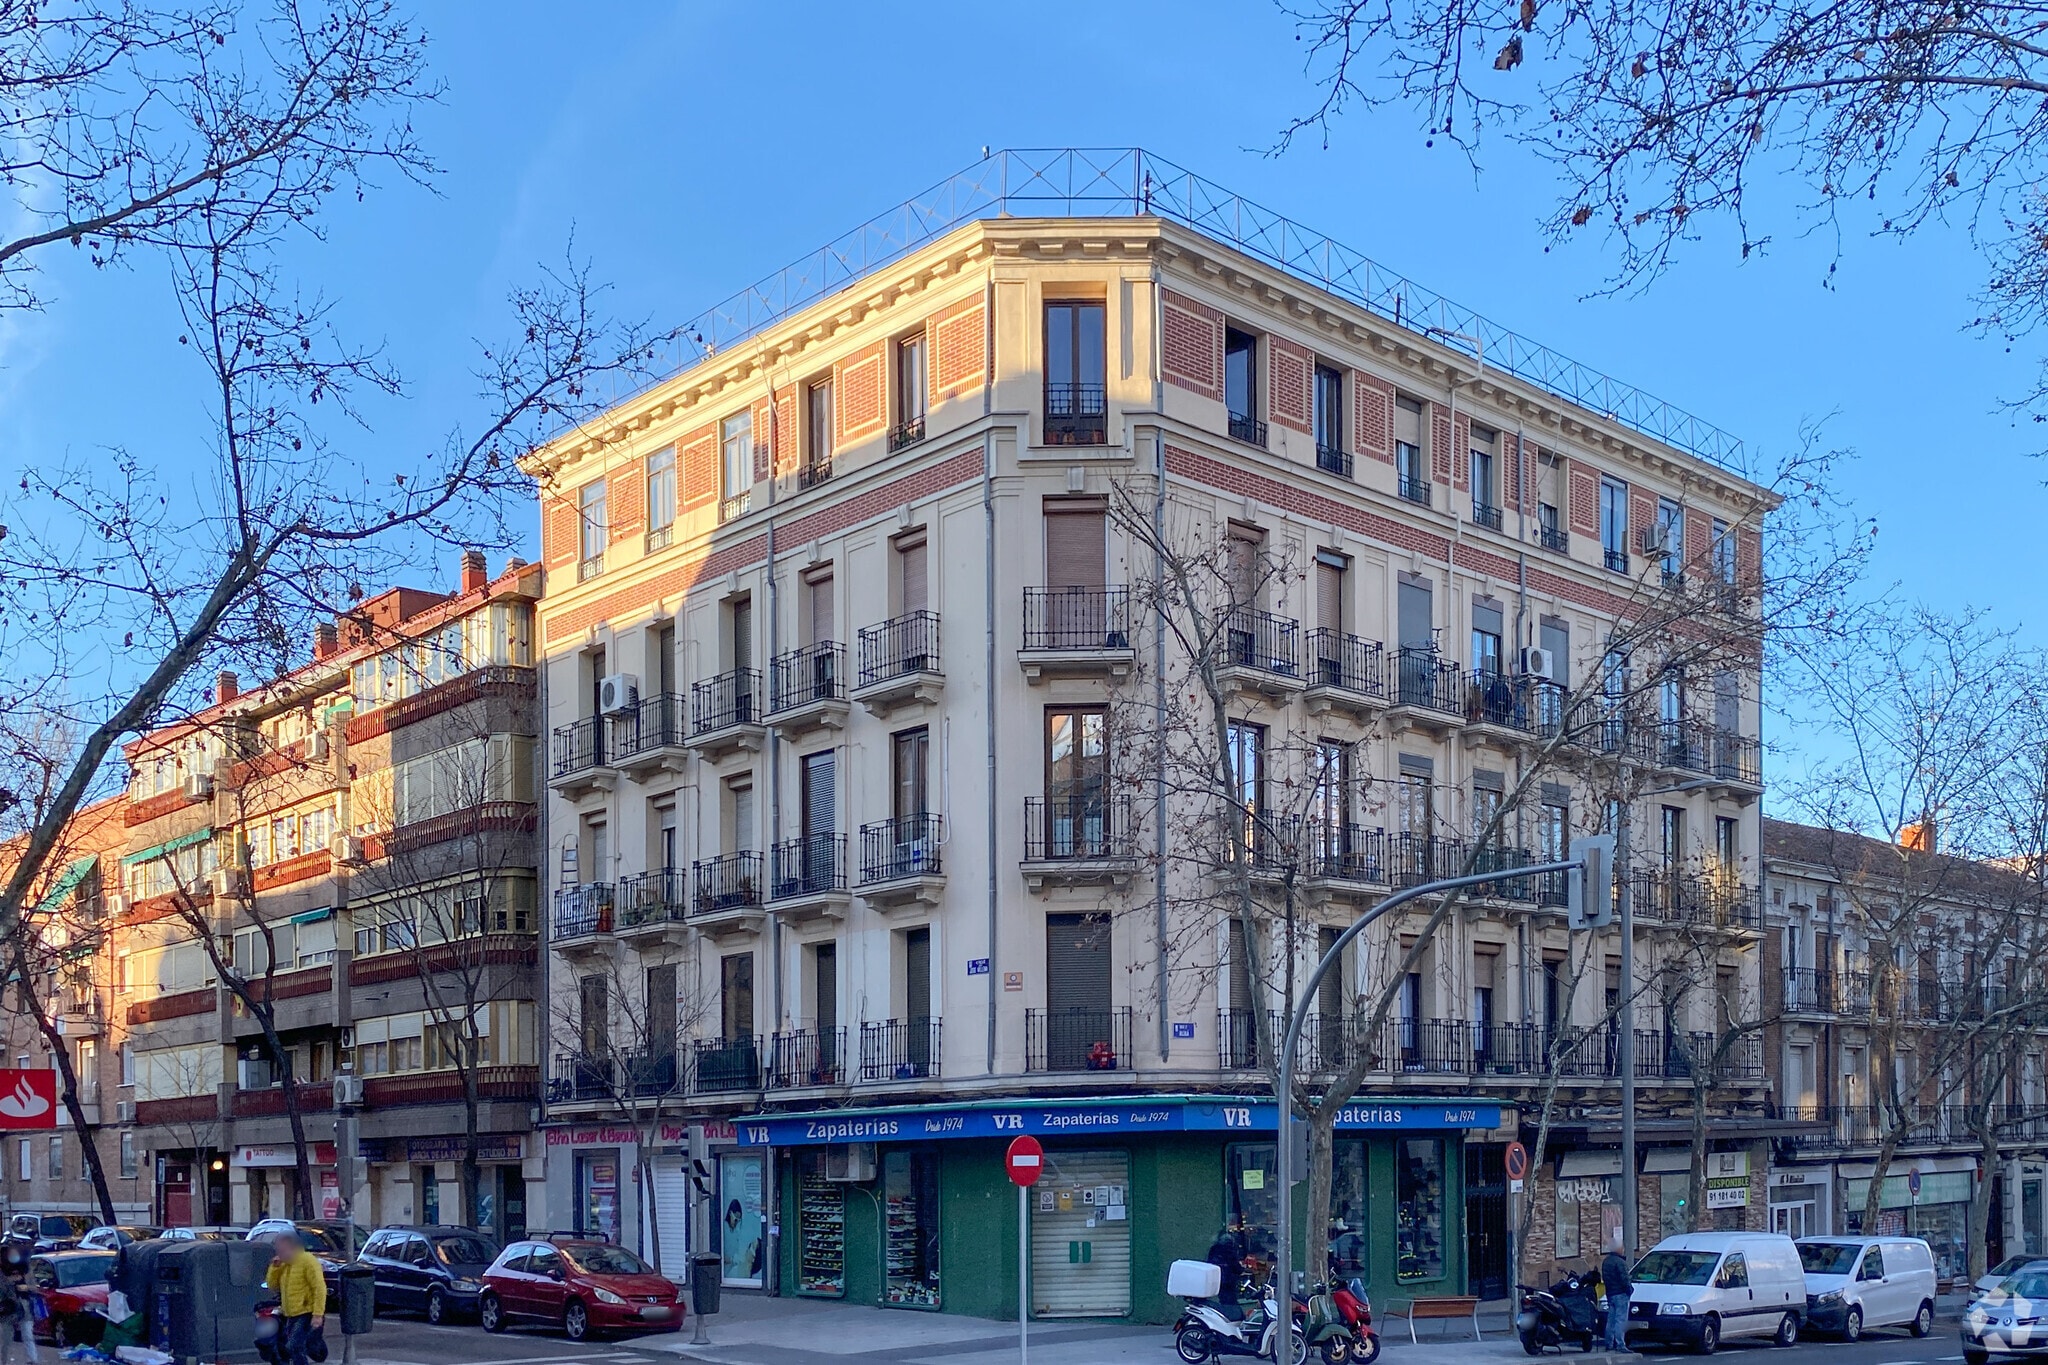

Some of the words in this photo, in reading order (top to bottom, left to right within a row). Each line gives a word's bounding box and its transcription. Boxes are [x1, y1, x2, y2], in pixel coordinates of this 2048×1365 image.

[993, 1114, 1024, 1129] VR
[1043, 1111, 1120, 1128] Zapaterías
[1148, 1111, 1169, 1122] 1974
[1223, 1107, 1251, 1127] VR
[1331, 1106, 1402, 1127] paterías
[1458, 1110, 1475, 1121] 1974
[571, 1126, 598, 1143] Laser
[747, 1126, 770, 1143] VR
[806, 1117, 899, 1142] Zapaterías
[942, 1117, 964, 1131] 1974
[253, 1149, 274, 1157] TATTOO
[441, 1150, 450, 1159] LA
[477, 1148, 506, 1158] ESTUDIO
[1708, 1177, 1749, 1189] DISPONIBLE
[1710, 1192, 1716, 1201] 91
[1718, 1191, 1728, 1200] 181
[1730, 1191, 1737, 1199] 40
[1738, 1190, 1745, 1199] 02
